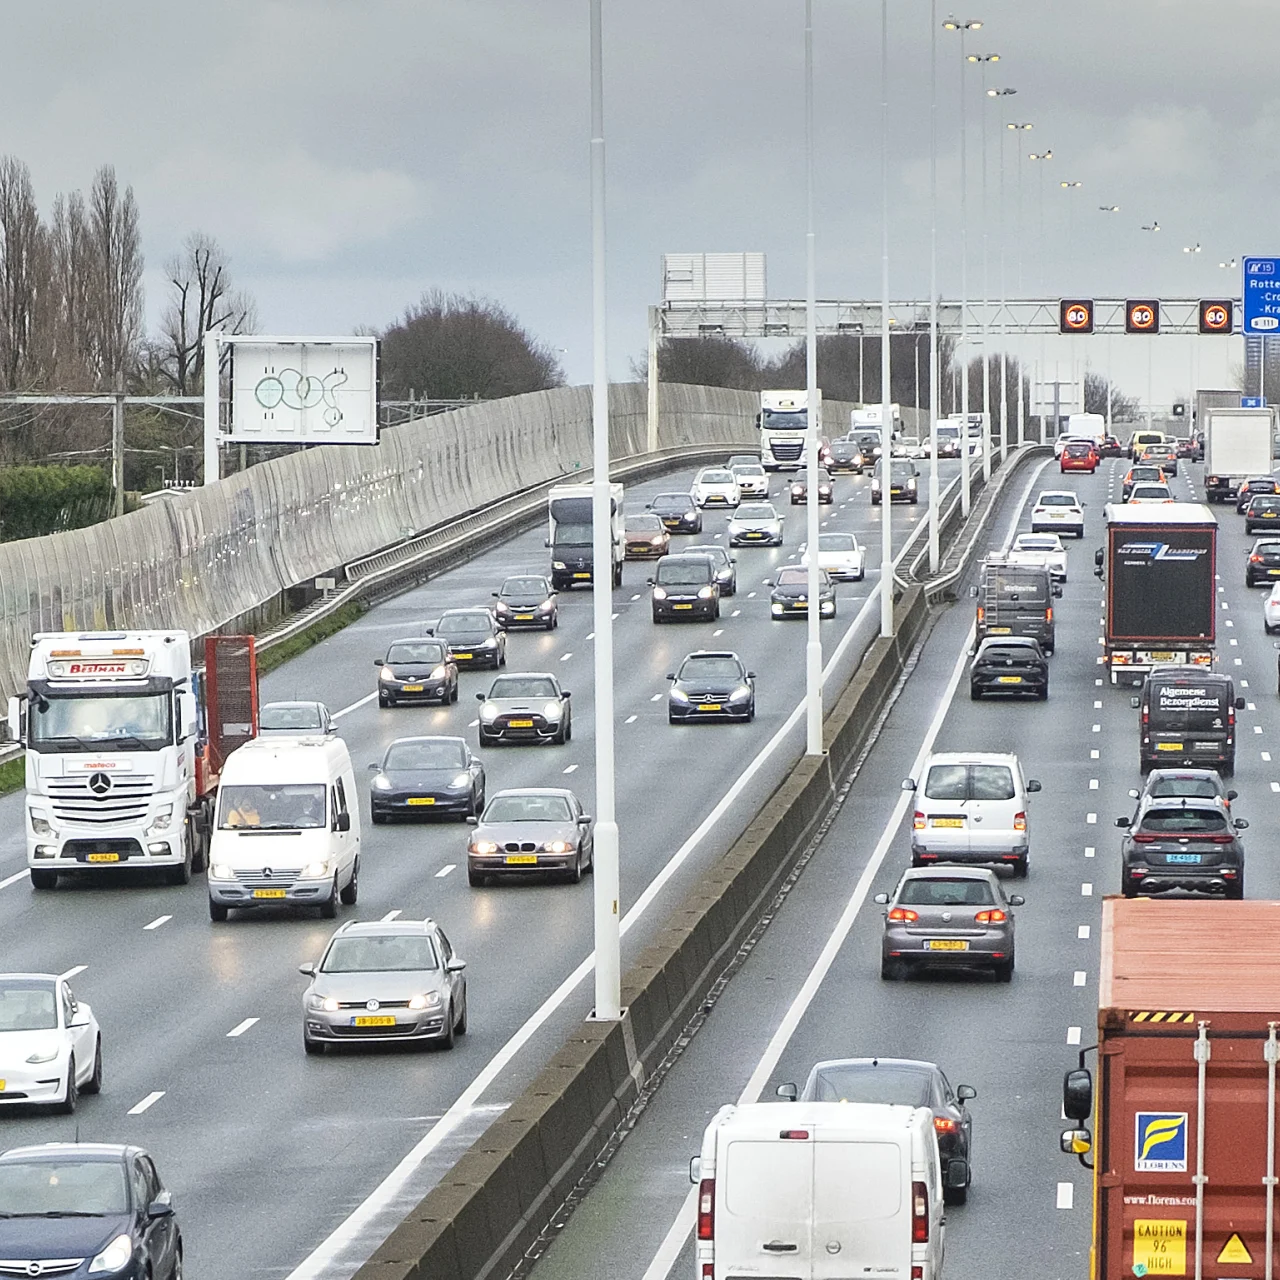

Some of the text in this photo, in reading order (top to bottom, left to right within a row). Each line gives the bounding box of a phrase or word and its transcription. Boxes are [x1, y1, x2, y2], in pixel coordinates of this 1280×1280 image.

[1068, 311, 1085, 322] 80
[1133, 311, 1150, 322] 80
[1207, 311, 1225, 322] 80
[70, 663, 126, 675] BESTMAN
[1160, 687, 1206, 697] Algemene
[1160, 697, 1219, 707] Bezorgdienst
[1137, 1161, 1185, 1169] FLORENS
[1138, 1225, 1182, 1237] CAUTION
[1147, 1257, 1172, 1269] HIGH
